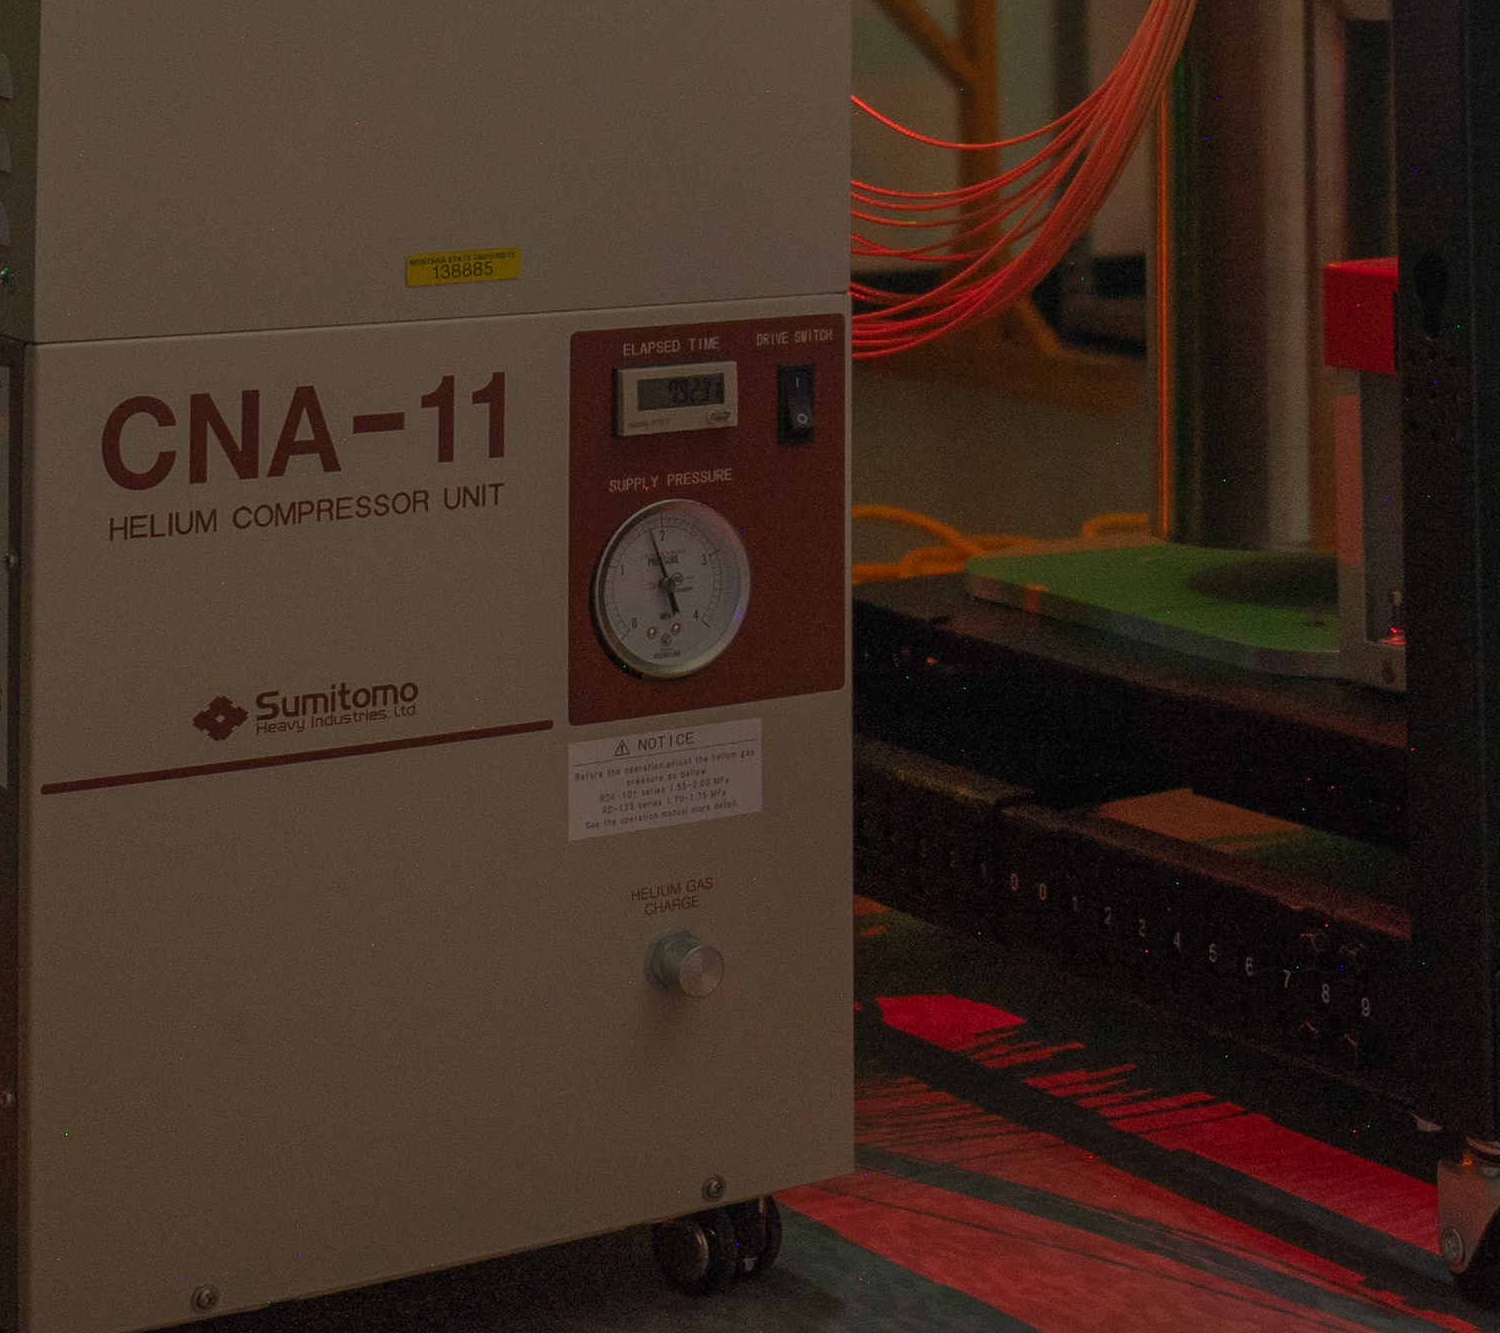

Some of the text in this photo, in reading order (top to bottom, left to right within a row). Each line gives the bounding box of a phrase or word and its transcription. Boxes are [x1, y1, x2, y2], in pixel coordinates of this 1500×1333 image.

[447, 254, 471, 264] STATE
[433, 261, 494, 280] 138885
[623, 336, 721, 357] ELAPSED TIME
[756, 328, 834, 347] DRIVE SWITCH
[101, 371, 505, 491] CNA-11
[608, 467, 733, 493] SUPPLY PRESSURE
[109, 483, 504, 542] HELIUM COMPRESSOR UNIT
[659, 529, 665, 541] 2
[647, 555, 679, 567] PRESURE
[701, 554, 707, 566] 3
[632, 617, 638, 629] 0
[255, 681, 419, 721] Sumitomo
[256, 719, 305, 735] Heavy
[637, 731, 695, 752] NOTICE
[574, 770, 604, 782] Before
[607, 767, 621, 777] the
[695, 755, 709, 765] the
[711, 751, 738, 763] helium
[740, 749, 756, 760] gas
[626, 773, 664, 788] pressure
[667, 773, 677, 781] as
[641, 786, 666, 797] series
[713, 776, 730, 786] MPa
[638, 799, 663, 810] series
[710, 788, 727, 799] MPa
[585, 821, 600, 830] See
[603, 818, 617, 828] the
[620, 812, 659, 825] operation
[661, 807, 689, 819] manual
[691, 805, 711, 815] more
[631, 876, 714, 902] HELIUM GAS
[644, 895, 700, 916] CHARGE
